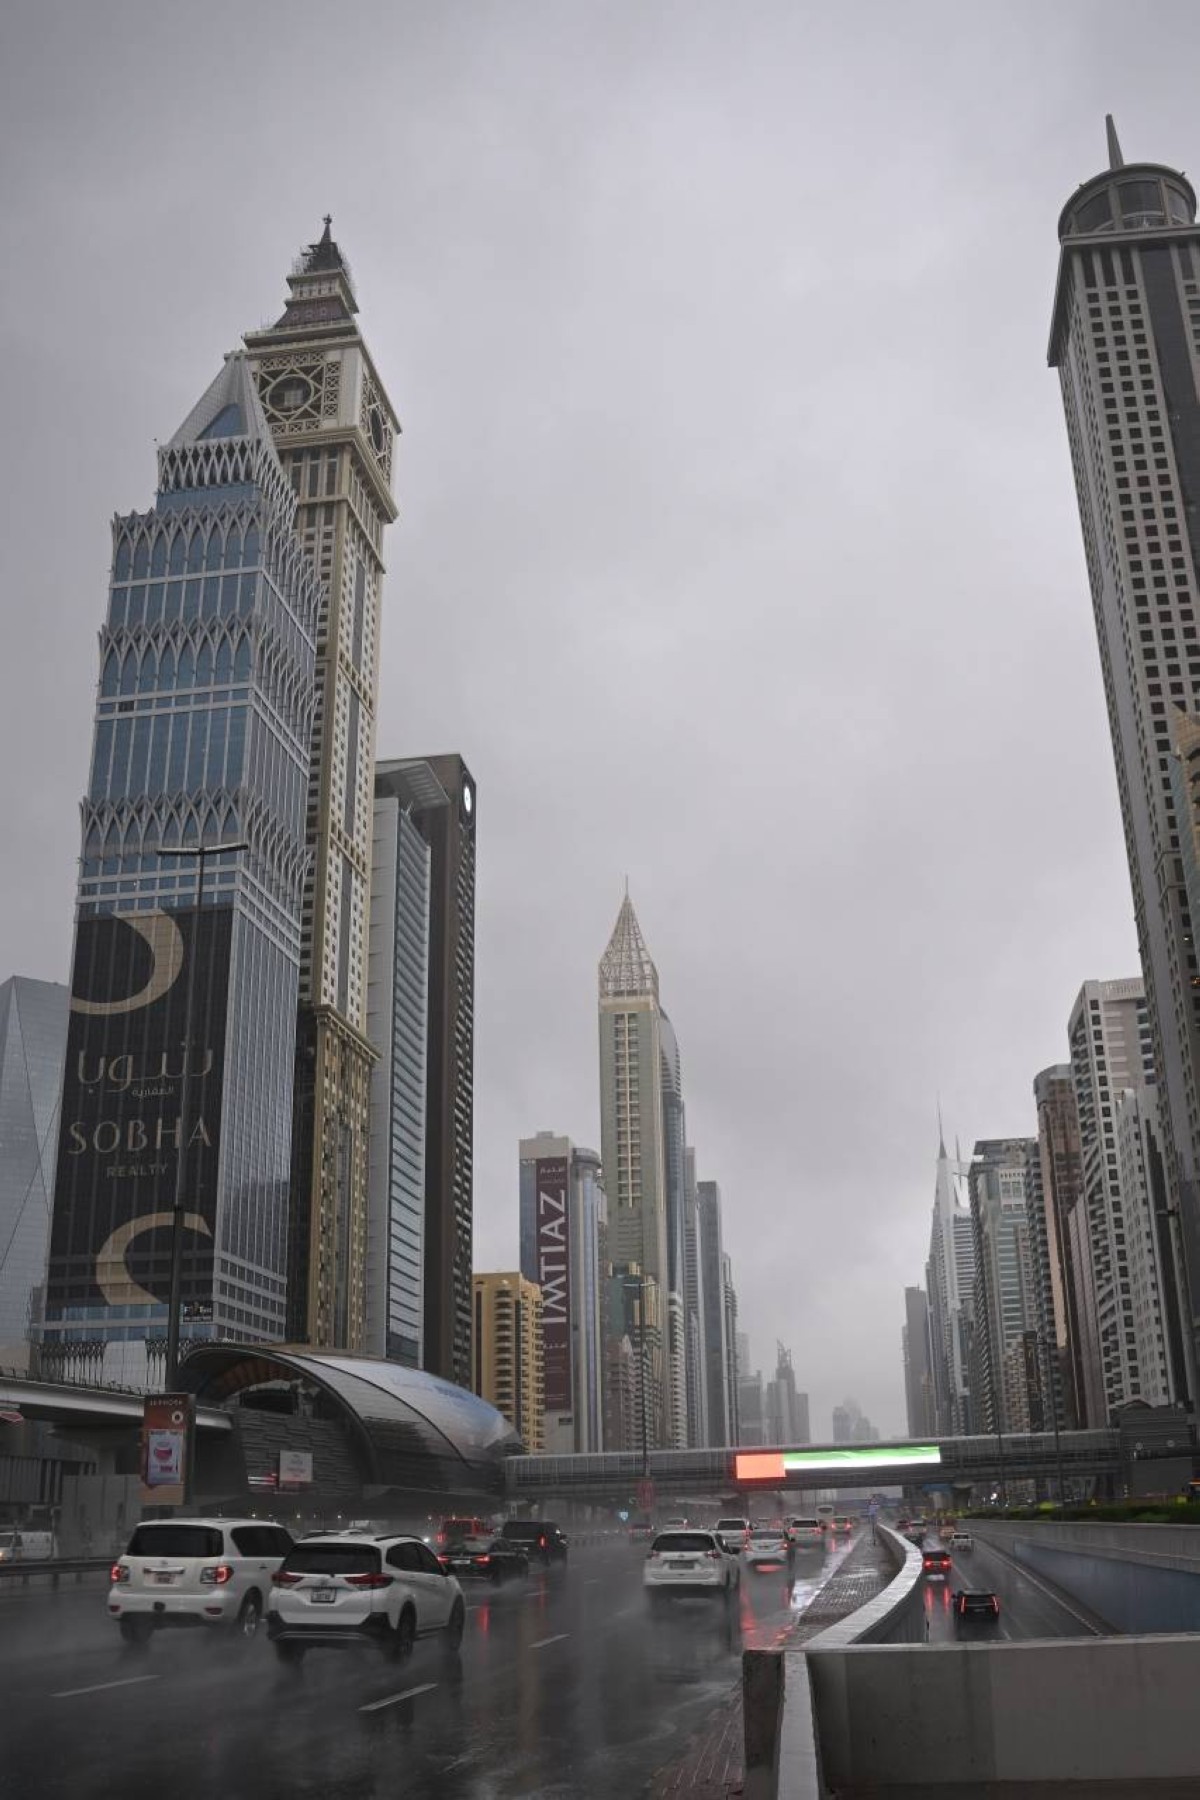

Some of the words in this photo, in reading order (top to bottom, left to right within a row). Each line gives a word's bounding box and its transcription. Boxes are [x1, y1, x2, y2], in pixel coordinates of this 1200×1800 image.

[68, 1117, 212, 1154] SOBHA
[107, 1163, 167, 1177] REALTY
[540, 1189, 567, 1323] IMTIAZ
